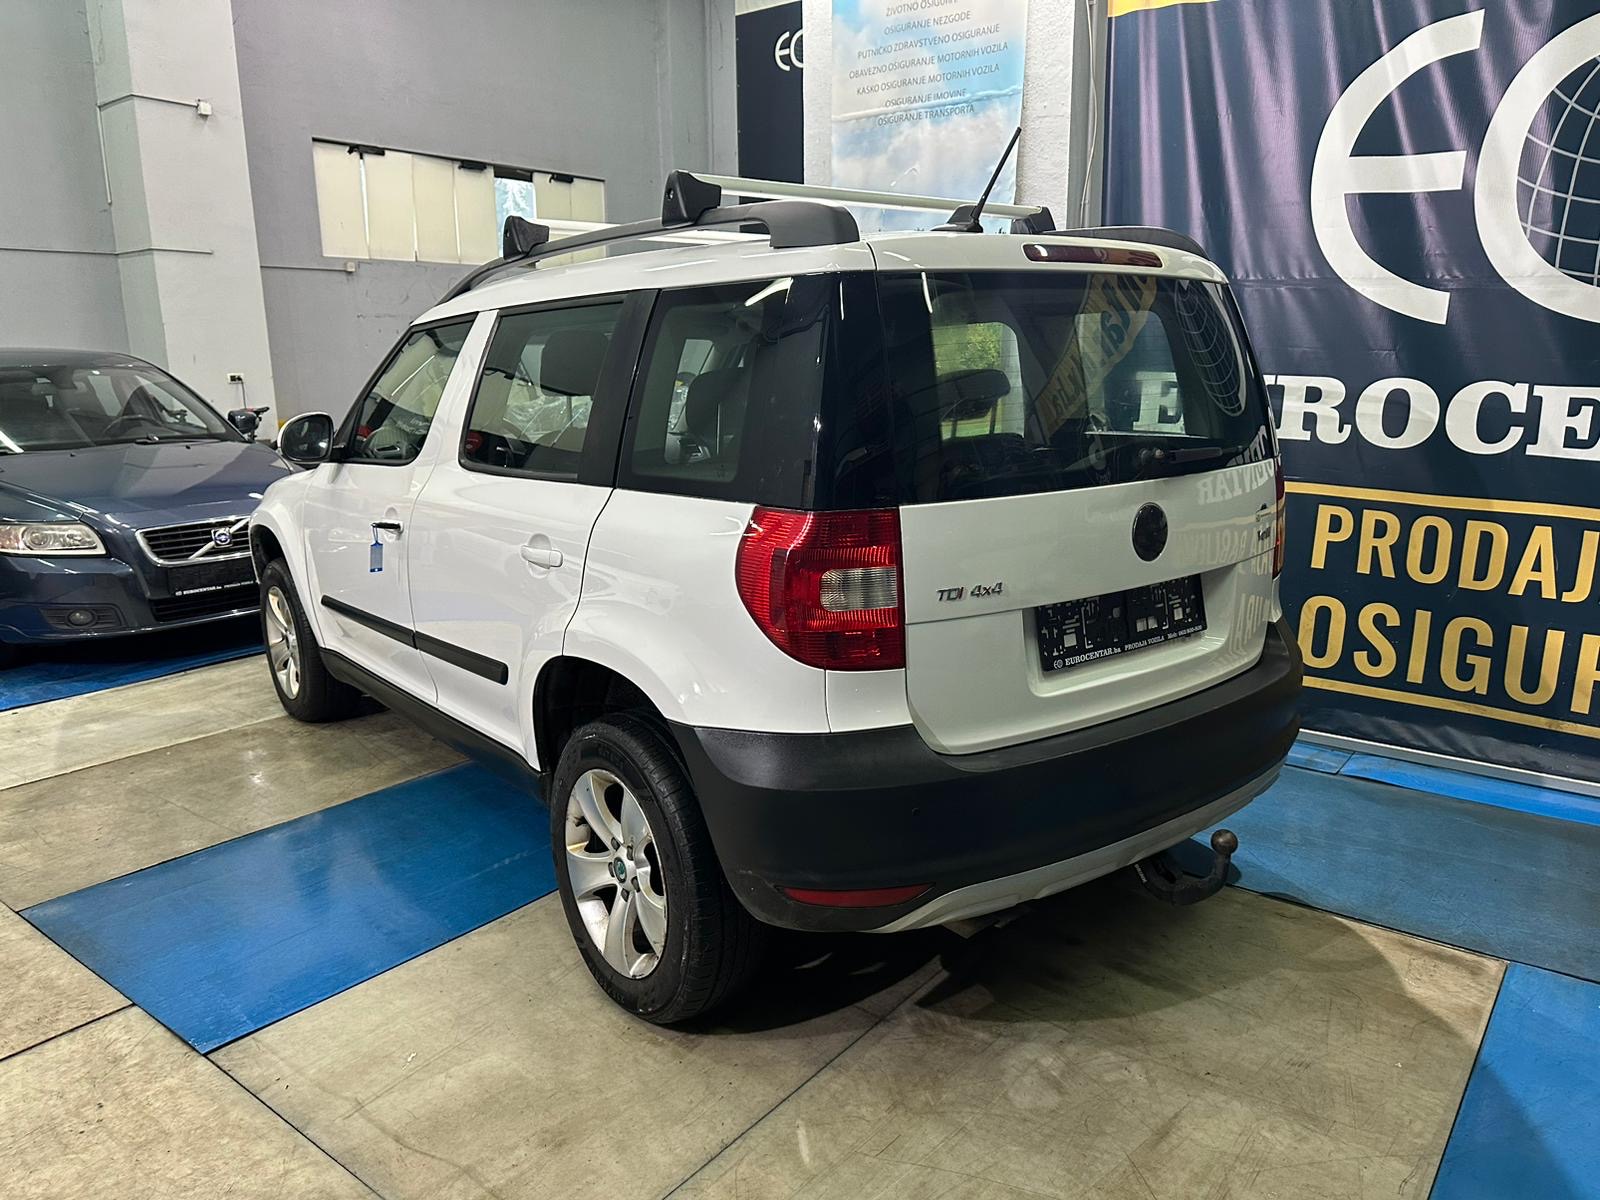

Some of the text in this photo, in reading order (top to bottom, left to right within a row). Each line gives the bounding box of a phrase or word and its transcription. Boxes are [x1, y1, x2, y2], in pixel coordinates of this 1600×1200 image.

[884, 10, 972, 35] OSIGURANJE NEZGODE
[893, 34, 951, 52] ZDRAVSTVENO
[951, 23, 1001, 42] OSIGURANJE
[848, 41, 1008, 79] OBAVEZNO OSIGURANJE MOTORNIH VOZILA
[880, 75, 927, 92] OSIGURANJE
[928, 67, 971, 83] MOTORNIH
[971, 63, 1000, 76] VOZILA
[885, 88, 967, 107] OSIGURANJE IMOVINE
[877, 104, 975, 127] OSIGURANJE TRANSPORTA
[1311, 504, 1600, 603] PRODAJ
[936, 582, 1003, 601] TDI 4x4
[1065, 646, 1121, 666] EUROCENTAR.ba
[1124, 639, 1148, 651] PRODAJA
